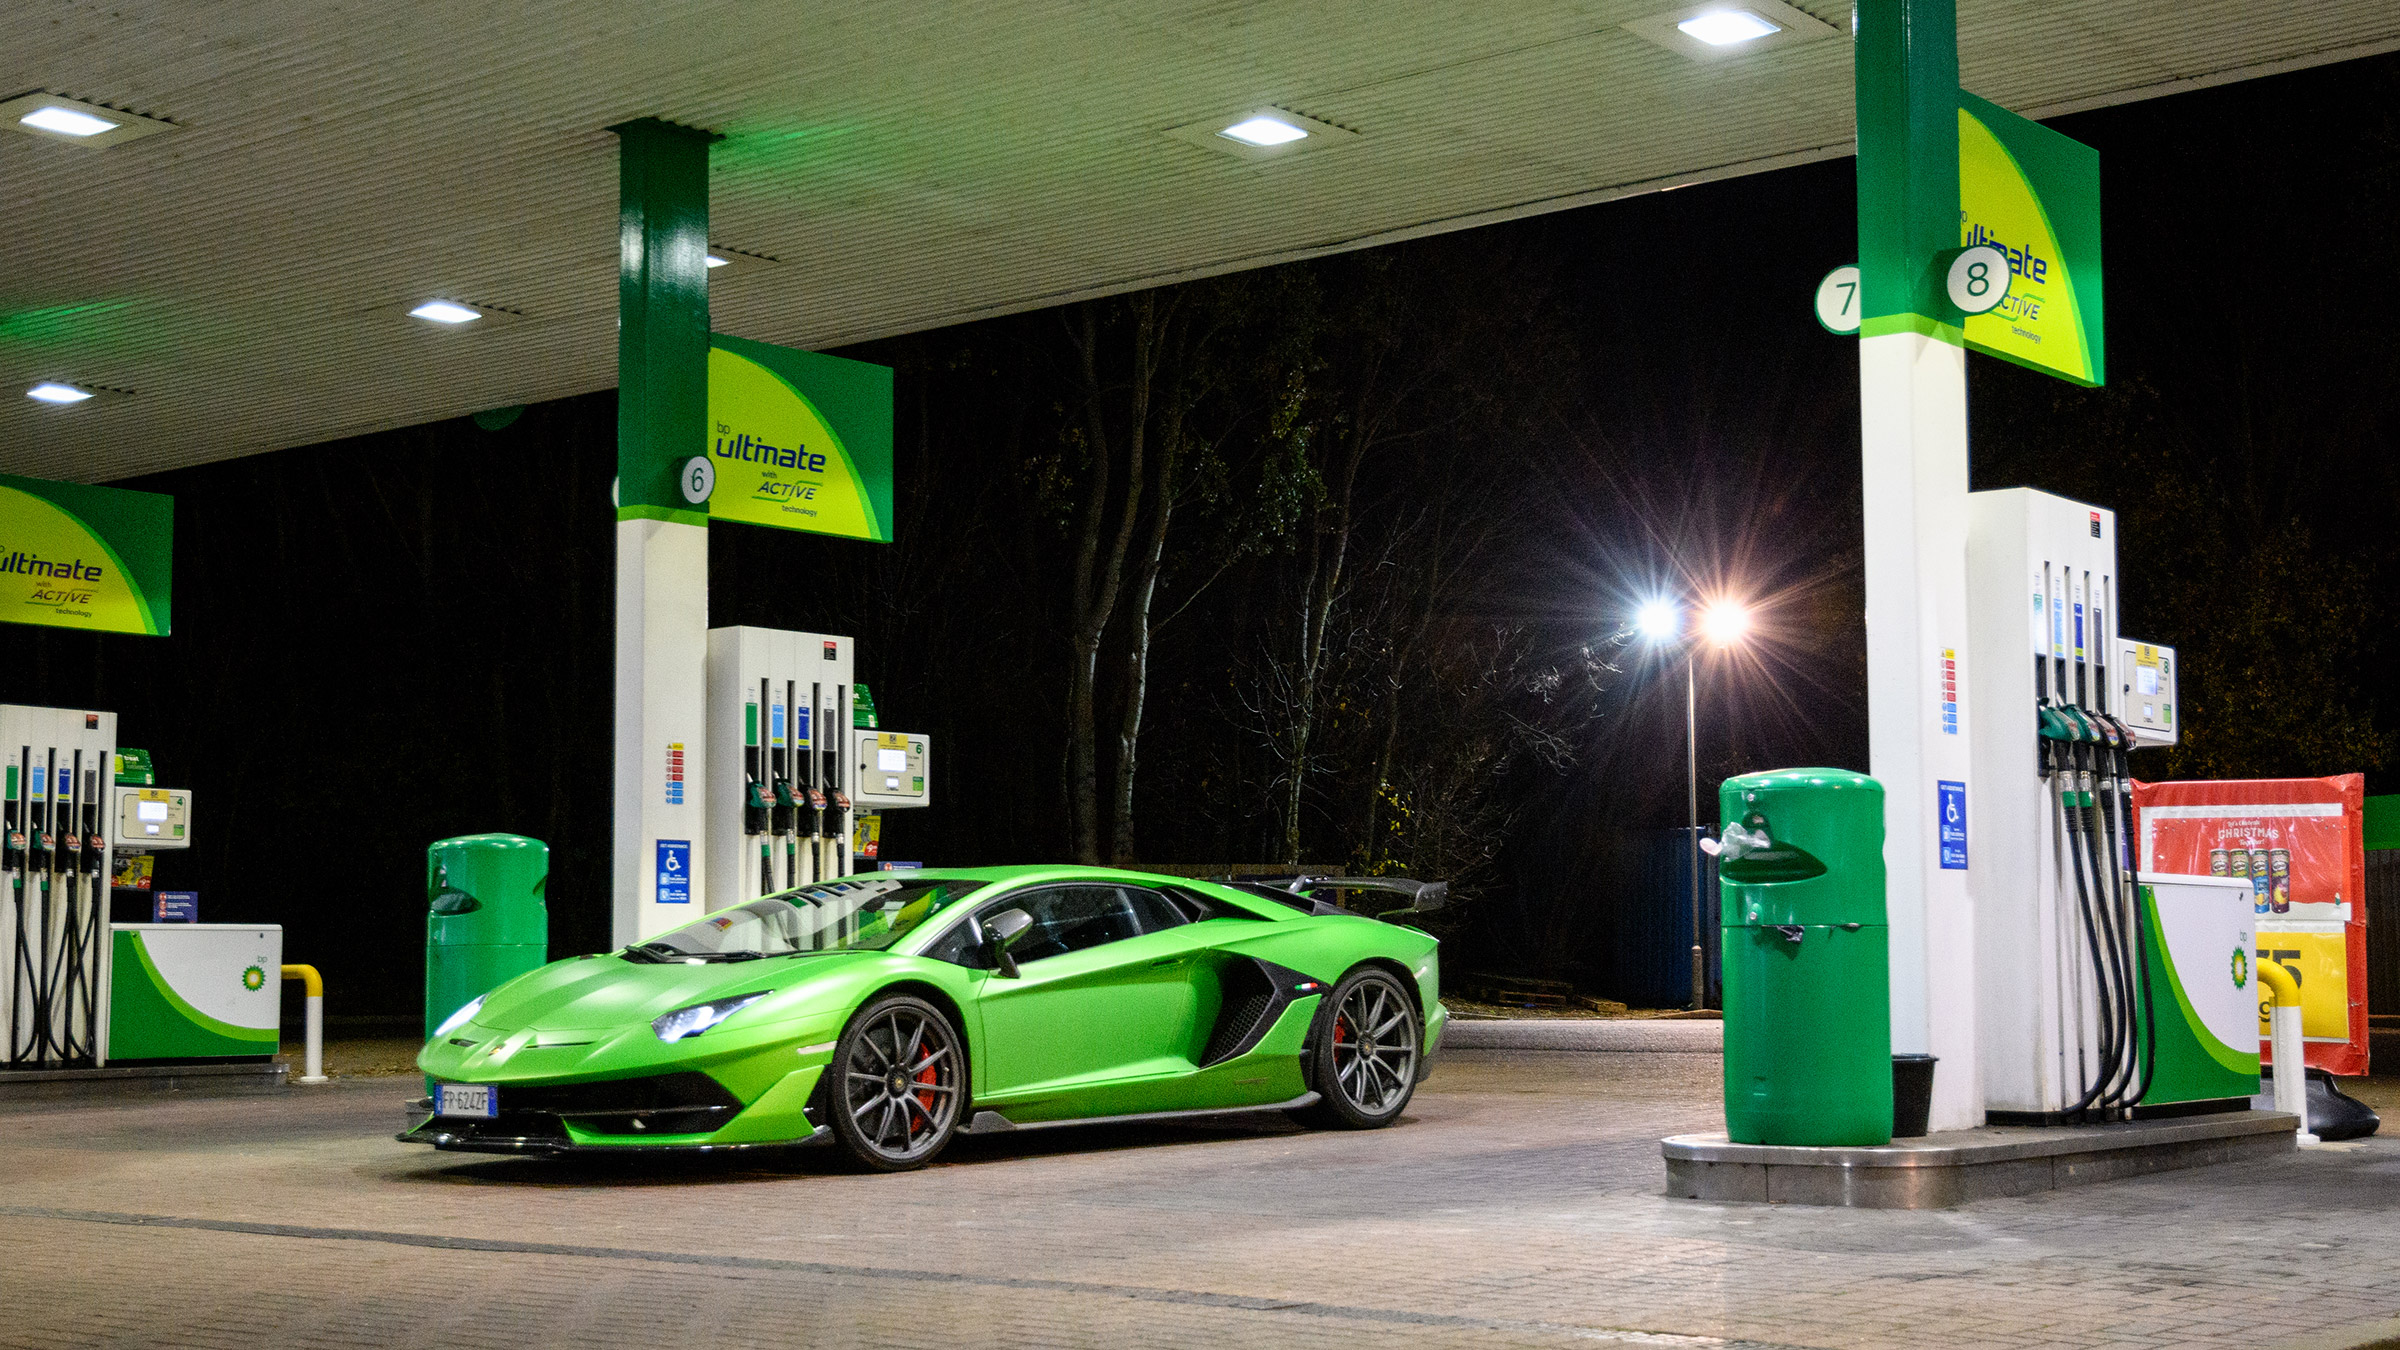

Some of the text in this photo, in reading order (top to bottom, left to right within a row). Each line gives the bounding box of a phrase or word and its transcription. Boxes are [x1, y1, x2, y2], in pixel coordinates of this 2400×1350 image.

[1966, 261, 1990, 297] 8
[1836, 282, 1856, 316] 7
[1997, 293, 2041, 322] CTIVE
[2011, 325, 2042, 345] technology
[716, 421, 731, 435] bp
[716, 433, 826, 473] ultimate
[691, 467, 704, 493] 6
[762, 471, 777, 479] with
[757, 481, 817, 500] ACTIVE
[782, 504, 818, 517] technology
[31, 589, 92, 604] ACTIVE
[55, 608, 92, 618] technology
[2163, 660, 2169, 674] 8
[915, 744, 923, 755] 6
[177, 797, 183, 806] 4
[2218, 827, 2279, 841] CHRISTMAS
[2239, 928, 2248, 944] bp
[257, 955, 268, 963] bp
